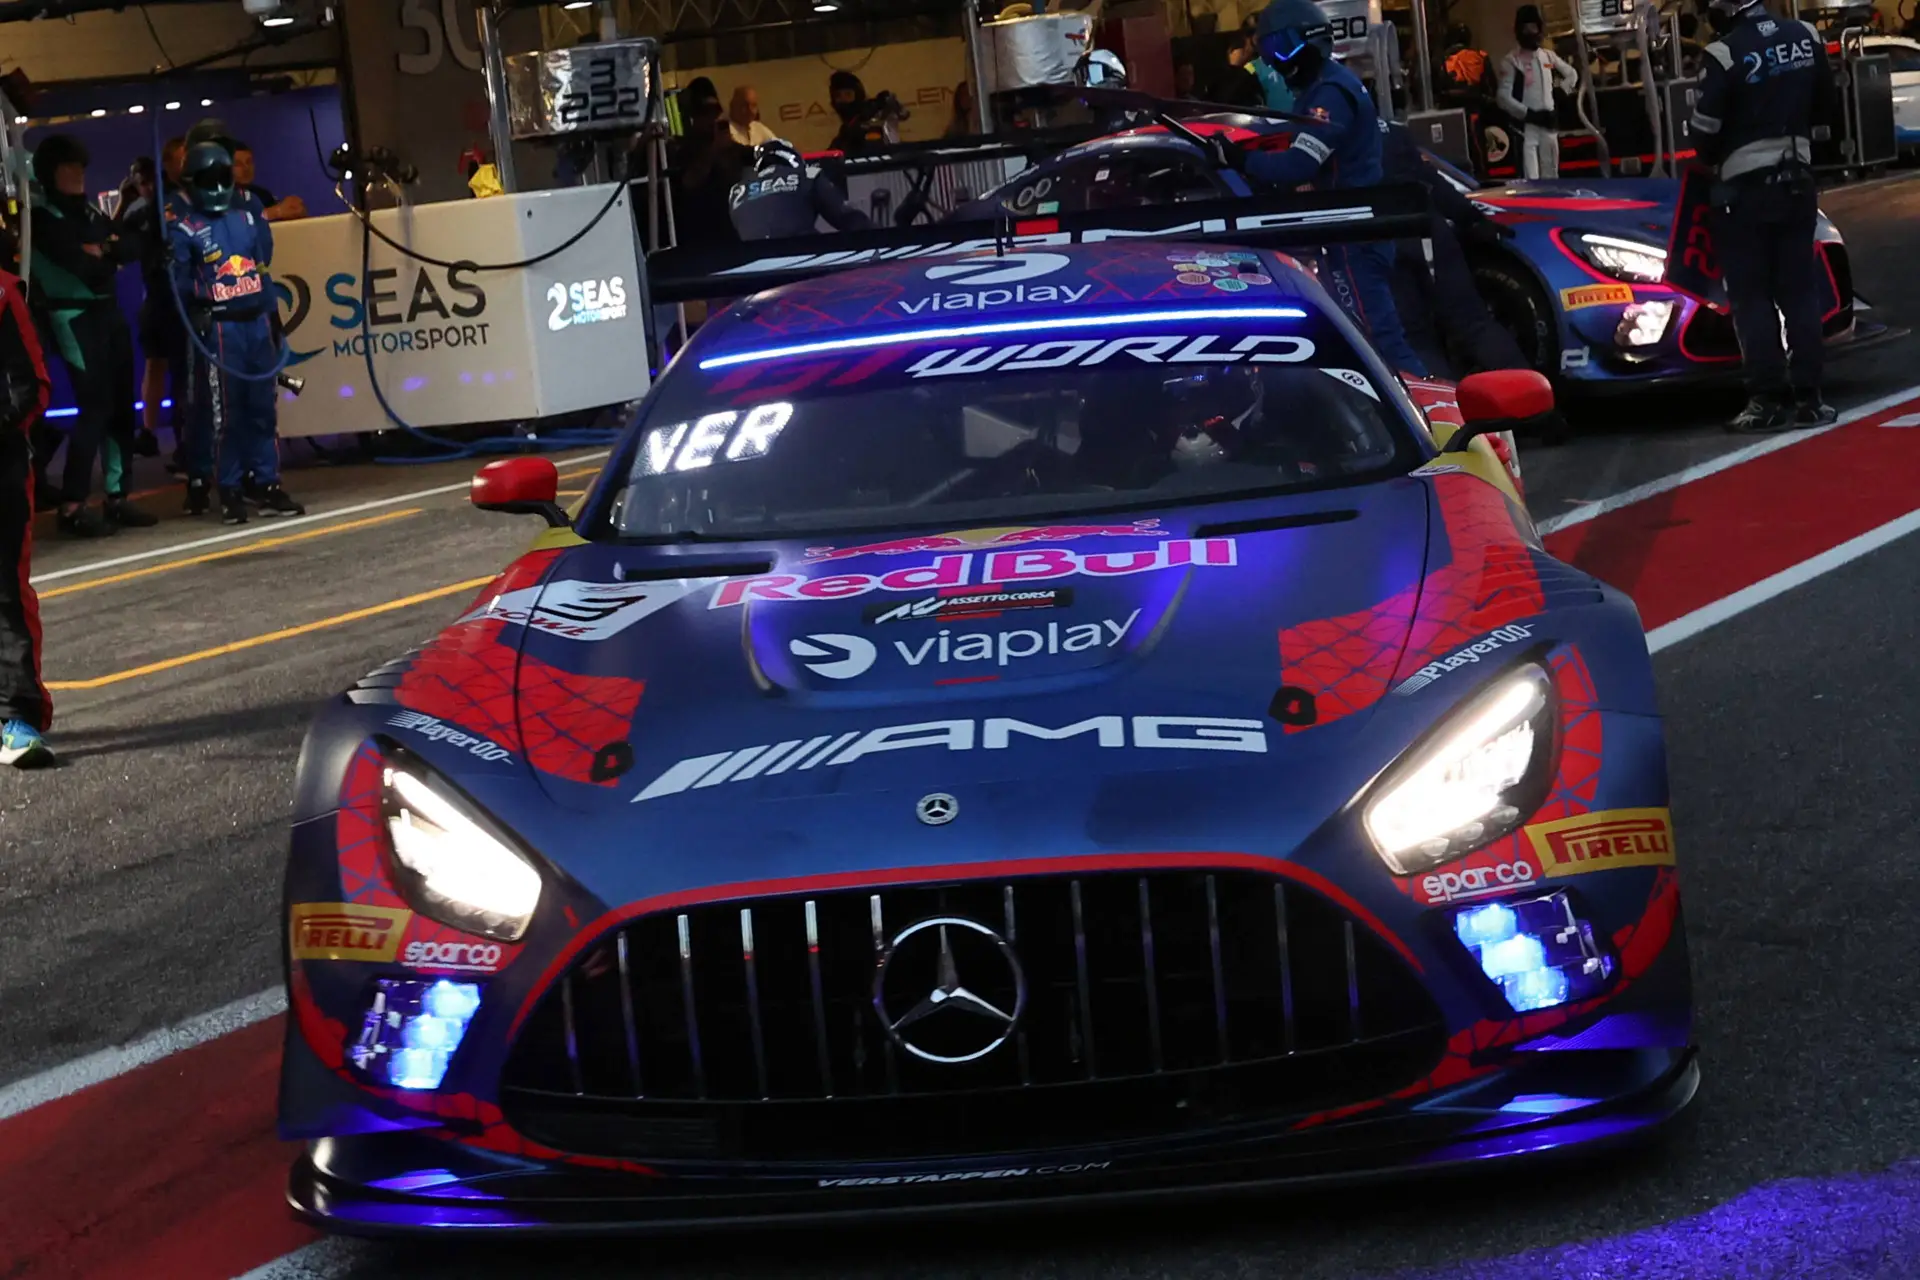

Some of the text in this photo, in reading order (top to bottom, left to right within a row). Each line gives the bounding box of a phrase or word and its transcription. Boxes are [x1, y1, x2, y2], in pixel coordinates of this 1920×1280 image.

[1765, 39, 1814, 67] SEAS
[748, 173, 799, 195] SEAS
[325, 259, 487, 330] SEAS
[569, 276, 626, 312] SEAS
[898, 283, 1093, 315] viaplay
[333, 323, 491, 358] MOTORSPORT
[905, 334, 1317, 379] WORLD
[647, 401, 795, 473] VER
[708, 538, 1238, 610] Red Bull
[947, 592, 1009, 606] ASSETTO
[1009, 589, 1057, 601] CORSA
[893, 606, 1144, 667] viaplay
[826, 714, 1268, 766] AMG
[1546, 816, 1669, 866] PIRELLI
[1422, 859, 1534, 901] sparco
[404, 940, 502, 968] sparco
